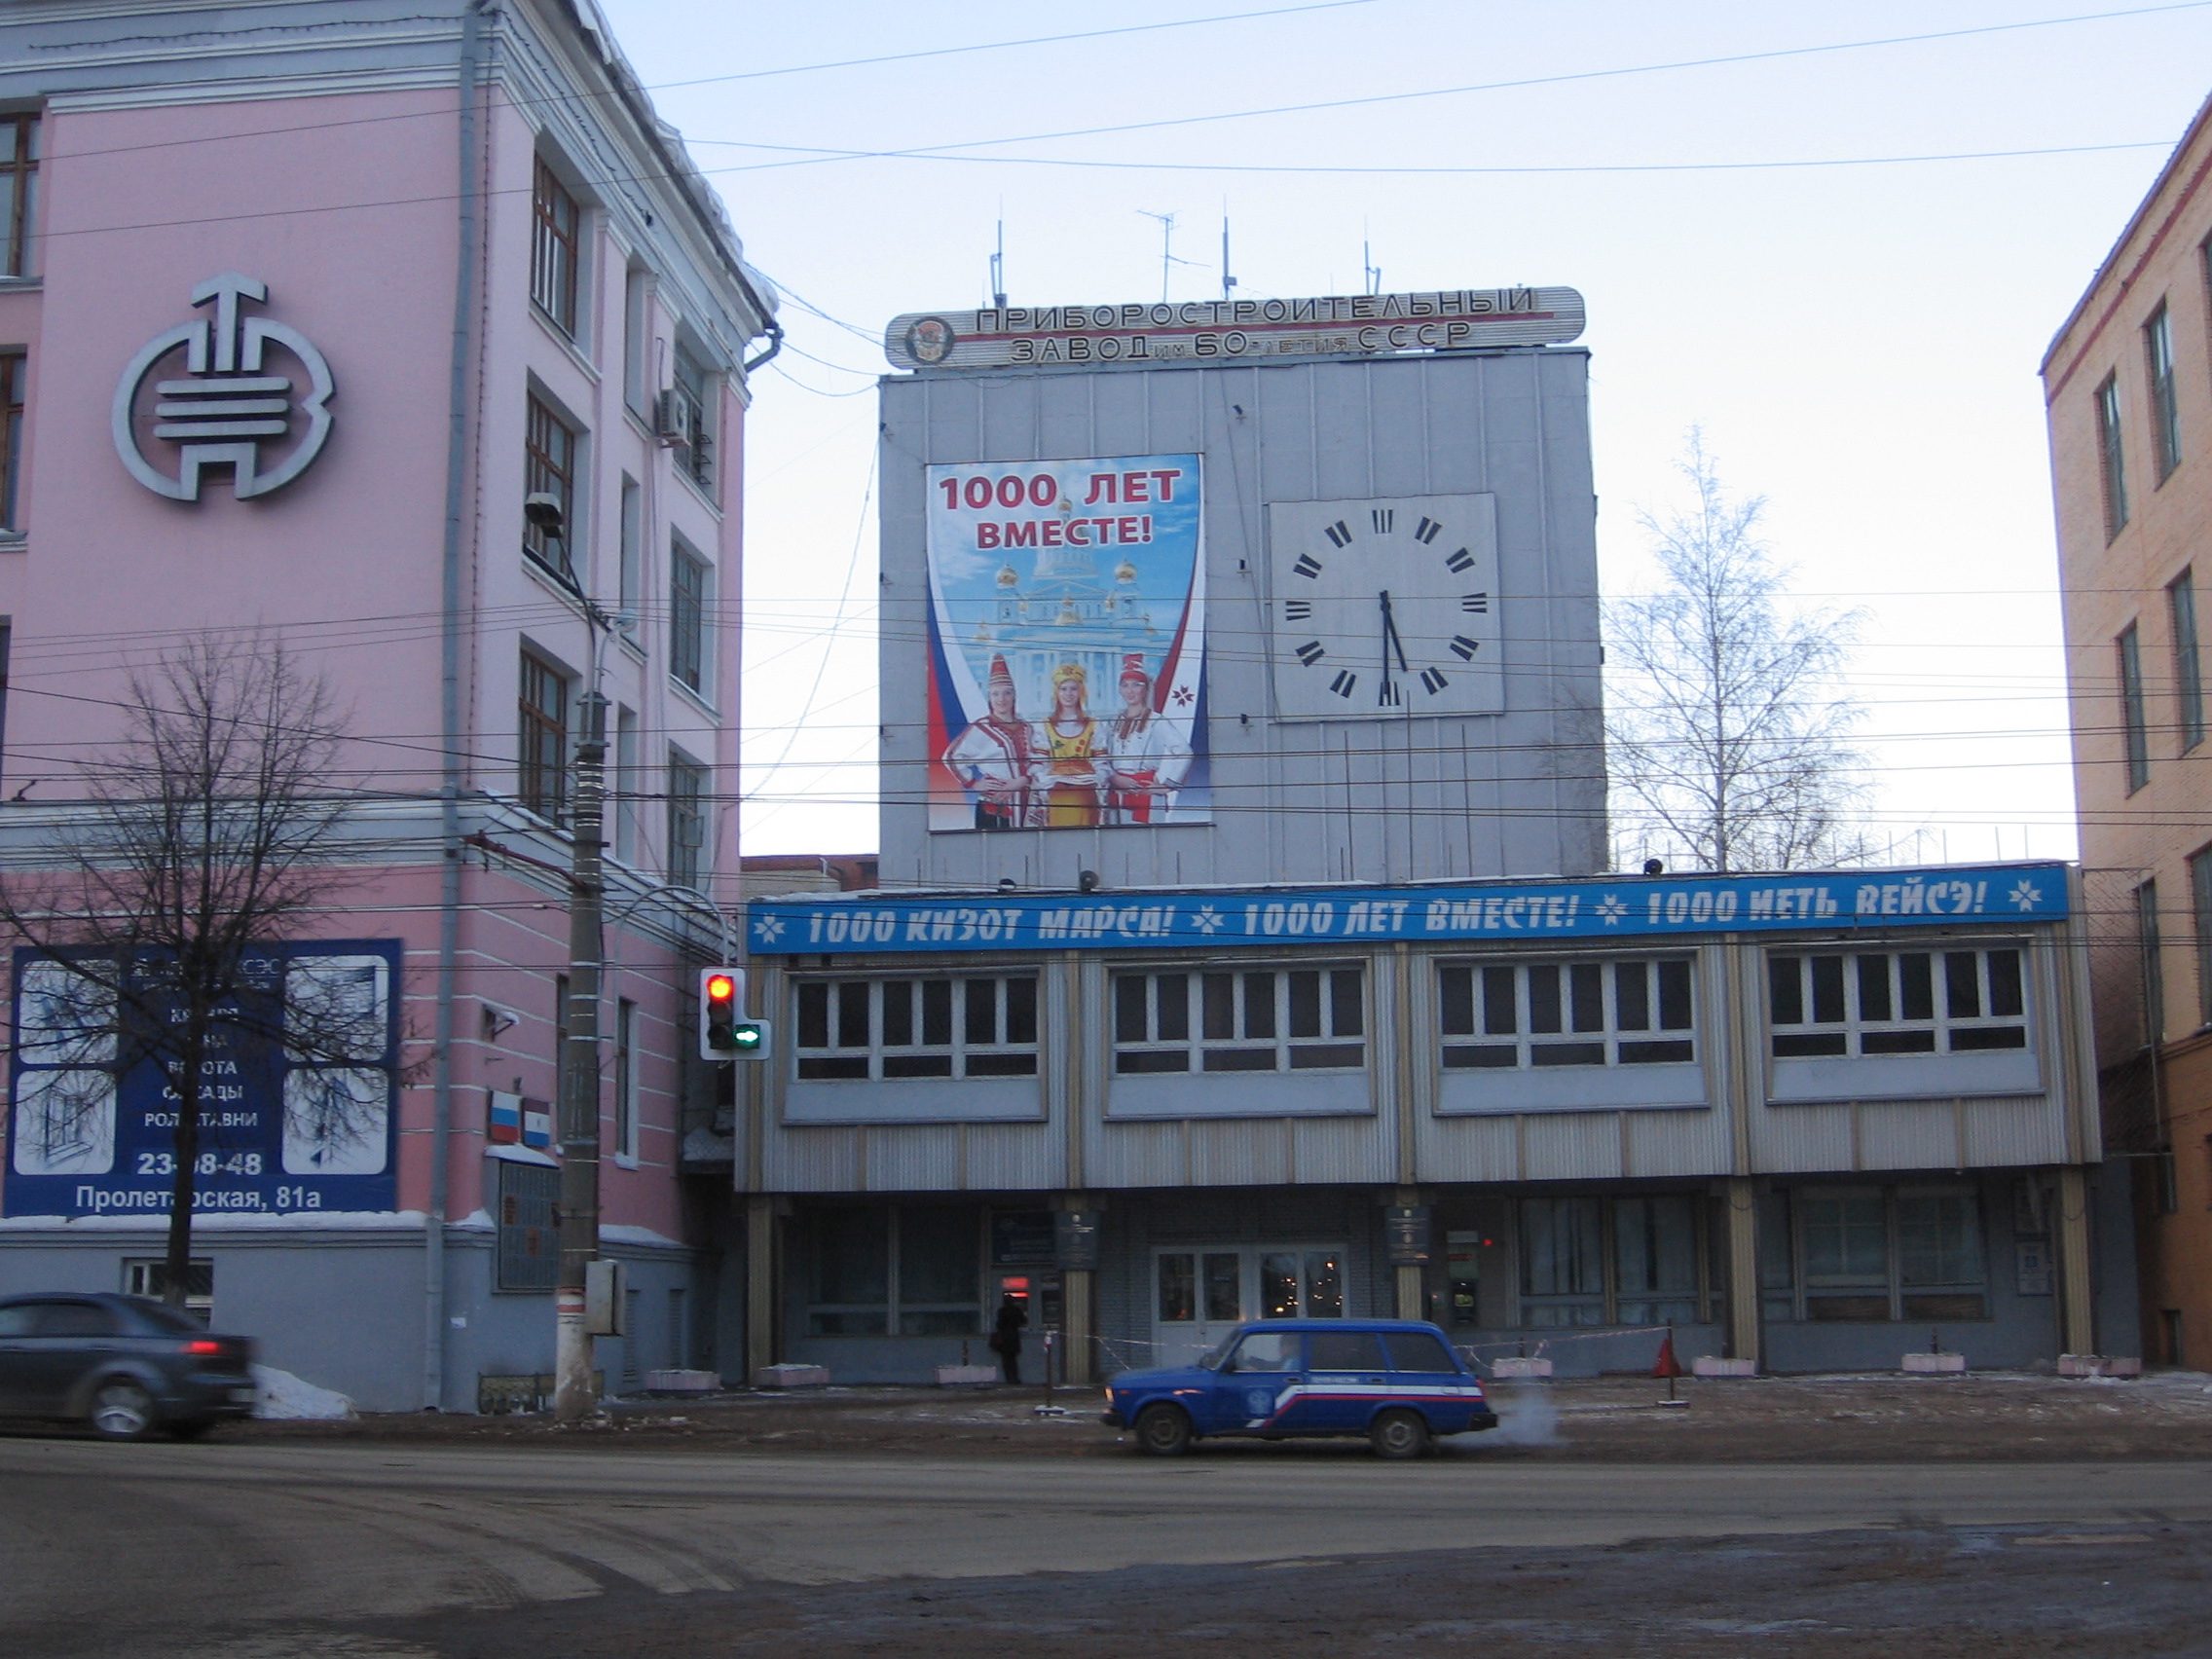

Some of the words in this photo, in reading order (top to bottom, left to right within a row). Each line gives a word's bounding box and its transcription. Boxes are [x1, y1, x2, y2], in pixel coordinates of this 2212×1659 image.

[976, 287, 1535, 333] ПРИБОРОСТРОИТЕЛЬНЫЙ
[1010, 335, 1151, 361] ЗАВОД
[1357, 321, 1471, 350] СССР
[939, 473, 1057, 510] 1000
[1084, 469, 1181, 505] ЛЕТ
[977, 516, 1153, 549] ВМЕСТЕ!
[809, 910, 896, 942] 1000
[905, 908, 1023, 941] КИЗОТ
[1038, 904, 1176, 940] МАРСА!
[1244, 902, 1333, 936] 1000
[1343, 900, 1410, 936] ЛЕТ
[1424, 895, 1580, 932] ВМЕСТЕ!
[1647, 890, 1738, 924] 1000
[1856, 876, 1987, 914] ВЕЙСЭ!
[167, 1060, 238, 1076] ВОТА
[144, 1112, 258, 1127] РОЛТАВНИ
[136, 1153, 263, 1176] 23-8-48
[76, 1186, 268, 1212] Пролетрская,
[276, 1186, 321, 1208] 81а
